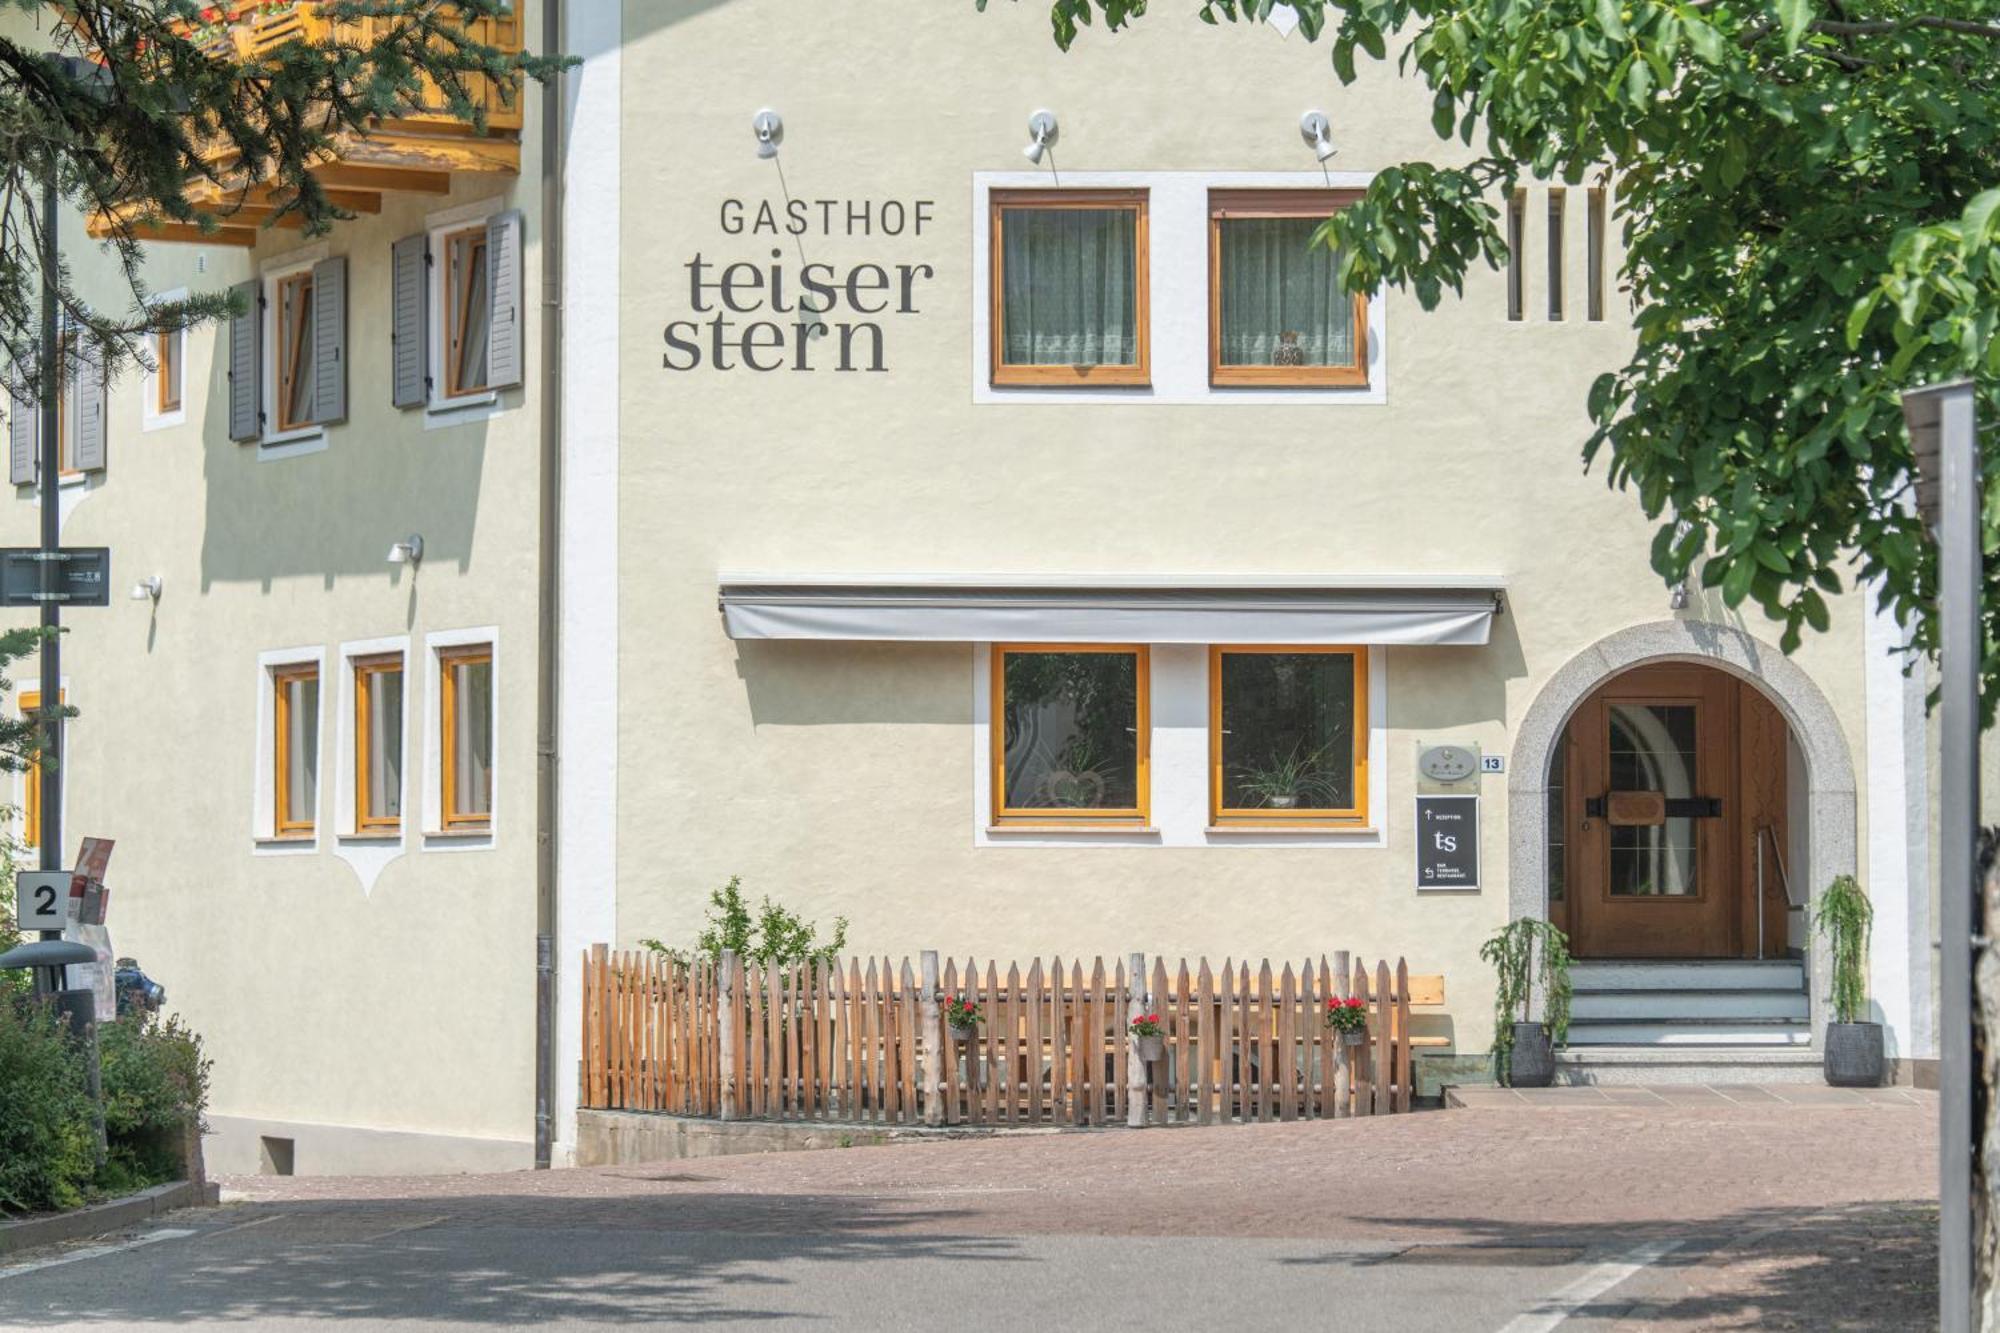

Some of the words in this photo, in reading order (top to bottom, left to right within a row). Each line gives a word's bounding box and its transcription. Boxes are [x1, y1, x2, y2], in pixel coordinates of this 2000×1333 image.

[721, 199, 935, 235] GASTHOF
[684, 248, 934, 313] teiser
[663, 311, 889, 372] stern
[1484, 759, 1500, 769] 13
[1433, 830, 1457, 852] ts
[34, 885, 57, 915] 2
